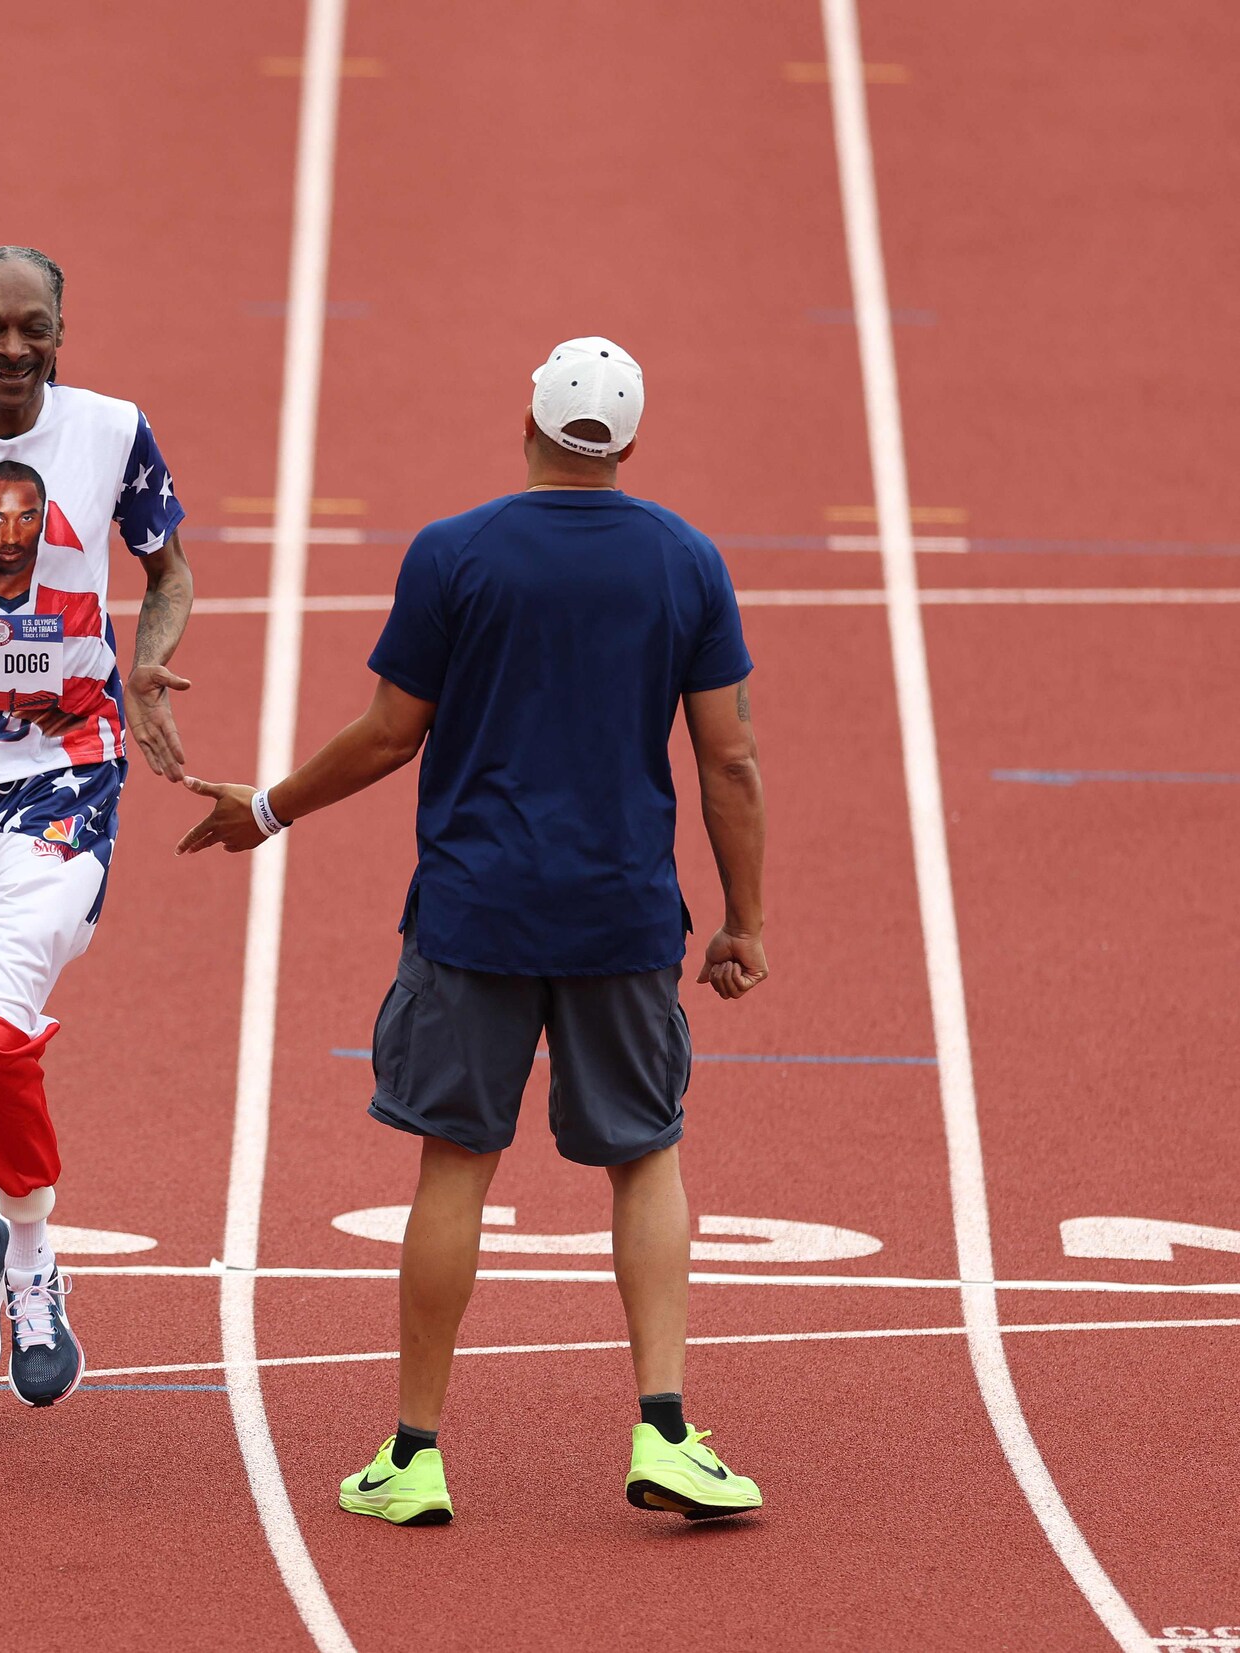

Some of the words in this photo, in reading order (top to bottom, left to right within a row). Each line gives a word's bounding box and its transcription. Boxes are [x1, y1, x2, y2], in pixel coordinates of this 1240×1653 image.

[34, 618, 58, 626] OLYMPIC
[38, 625, 58, 633] TRIALS
[4, 653, 50, 674] DOGG
[258, 797, 271, 822] TRIALS
